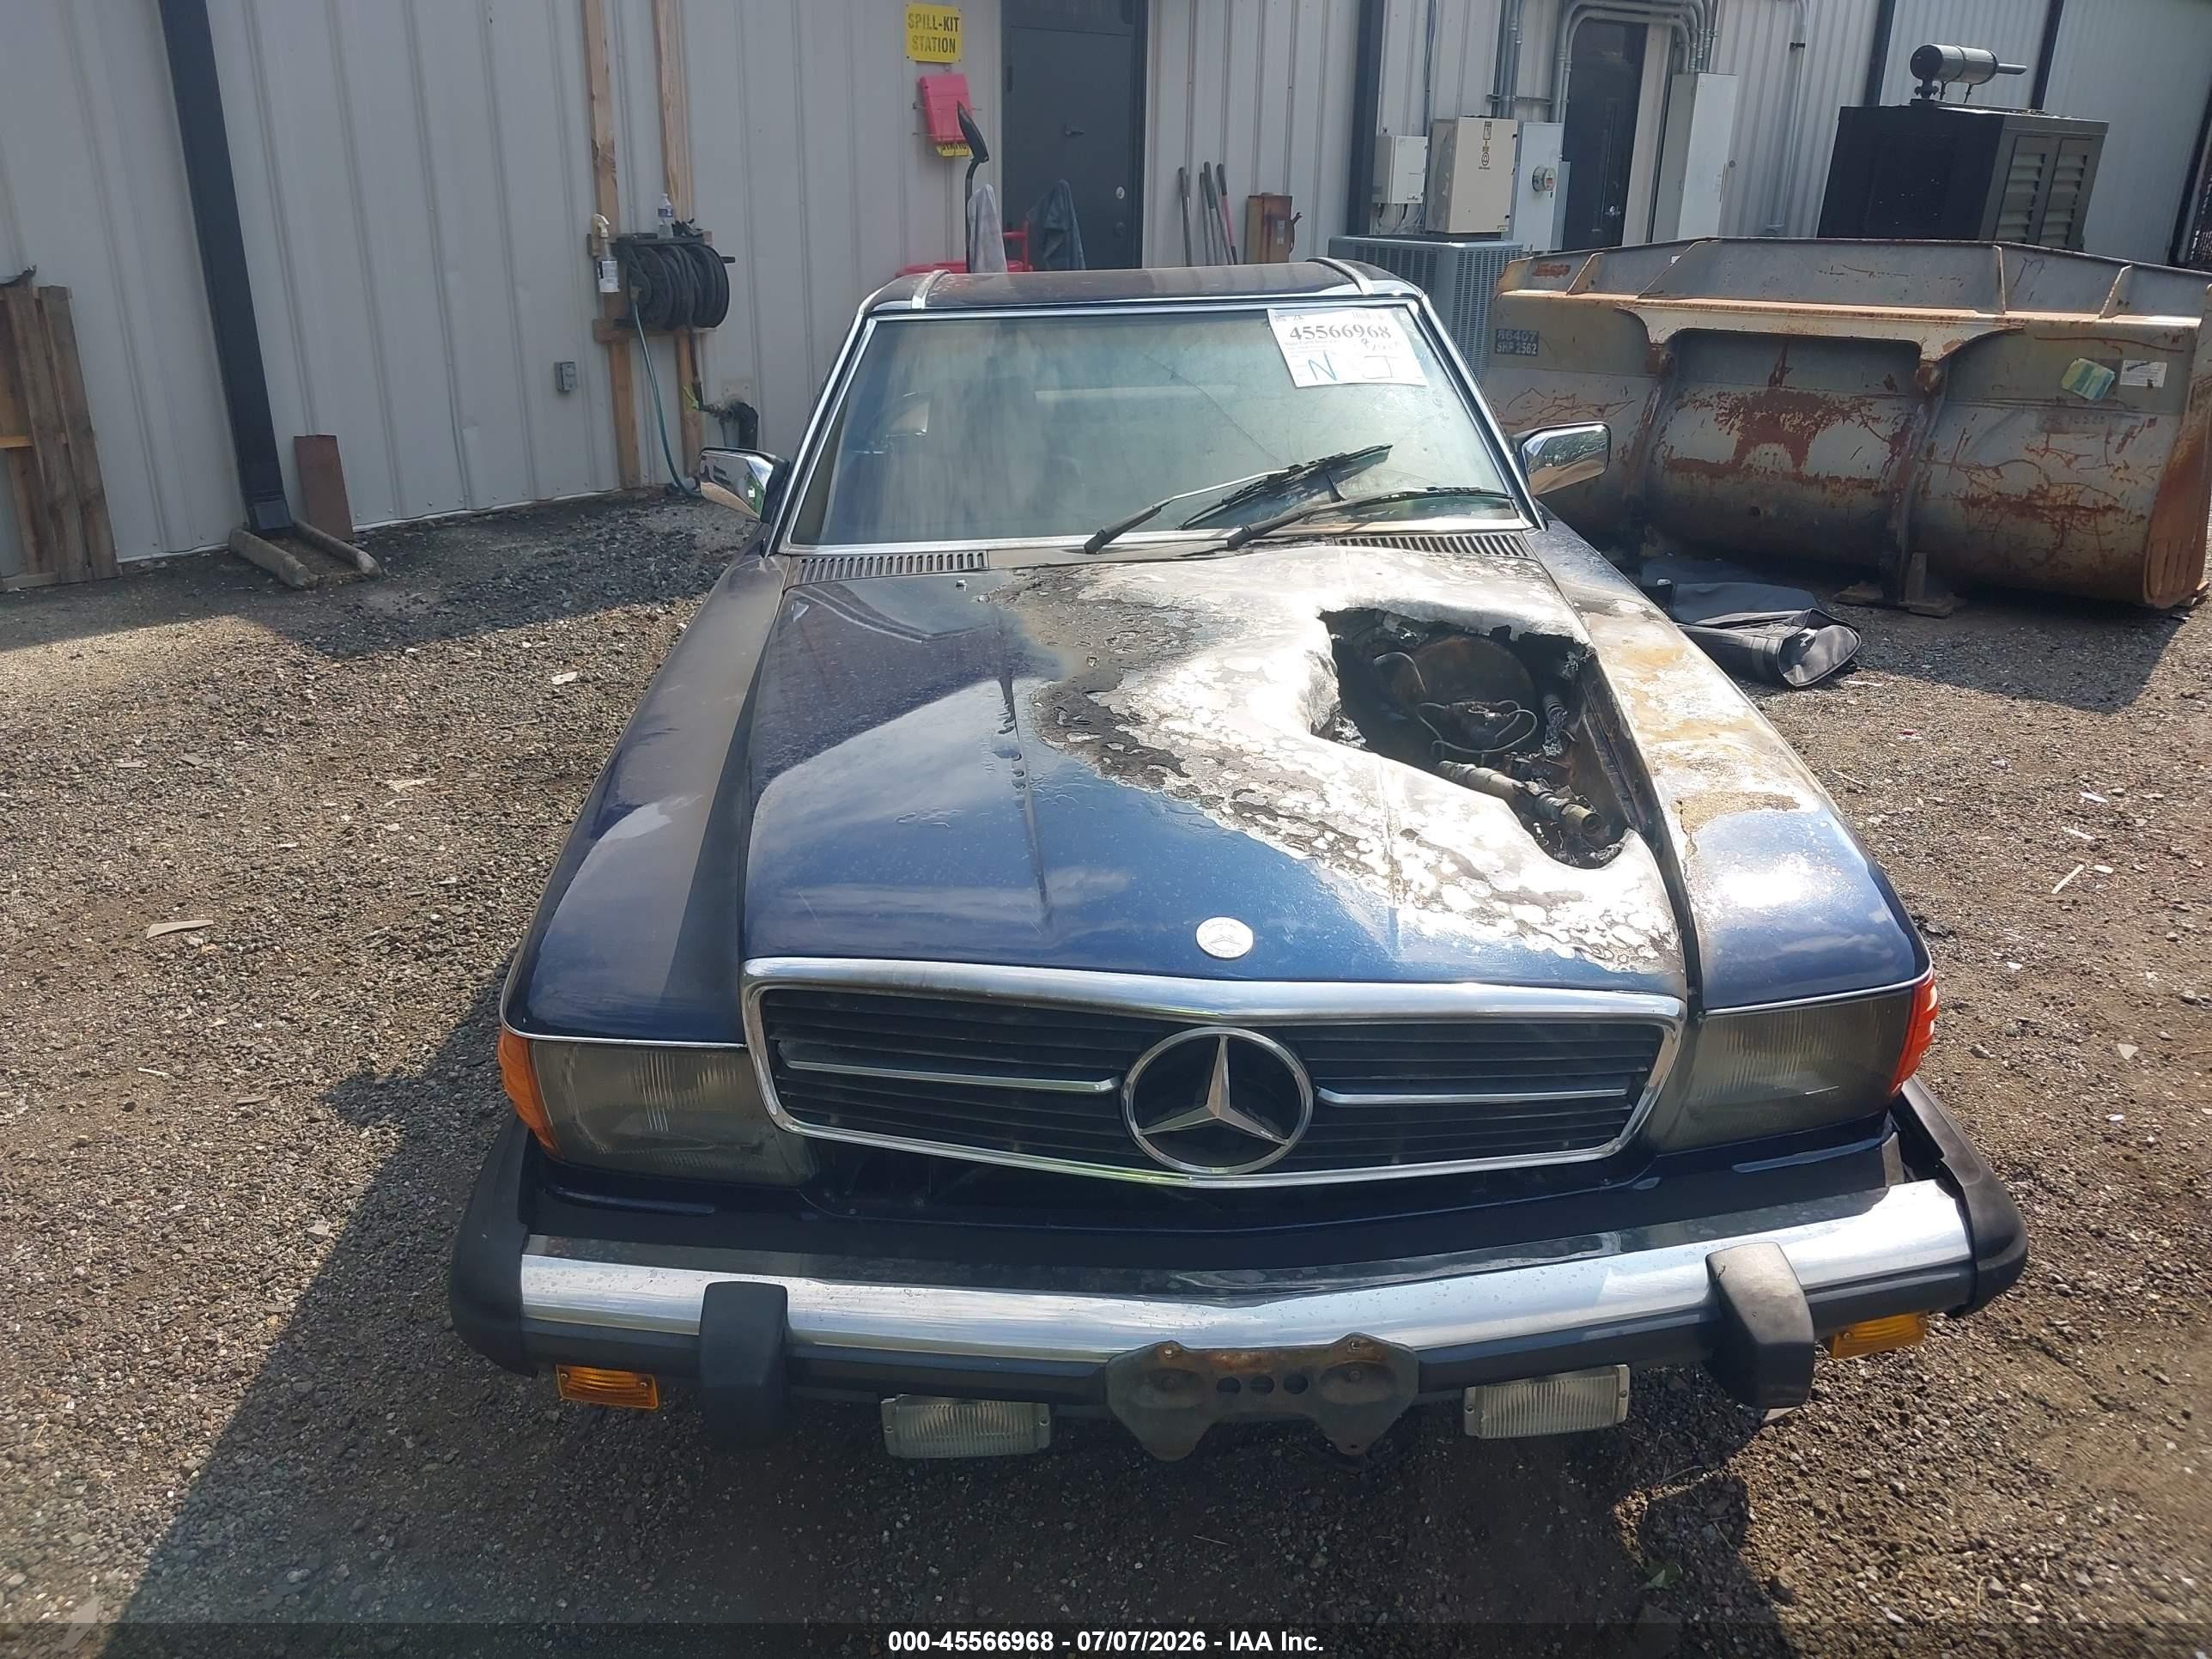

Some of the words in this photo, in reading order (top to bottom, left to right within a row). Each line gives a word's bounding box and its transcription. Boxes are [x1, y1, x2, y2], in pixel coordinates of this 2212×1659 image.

[908, 13, 959, 33] SPILL-KIT
[911, 34, 956, 54] STATION
[1290, 324, 1391, 340] 45566968
[1308, 349, 1338, 381] N
